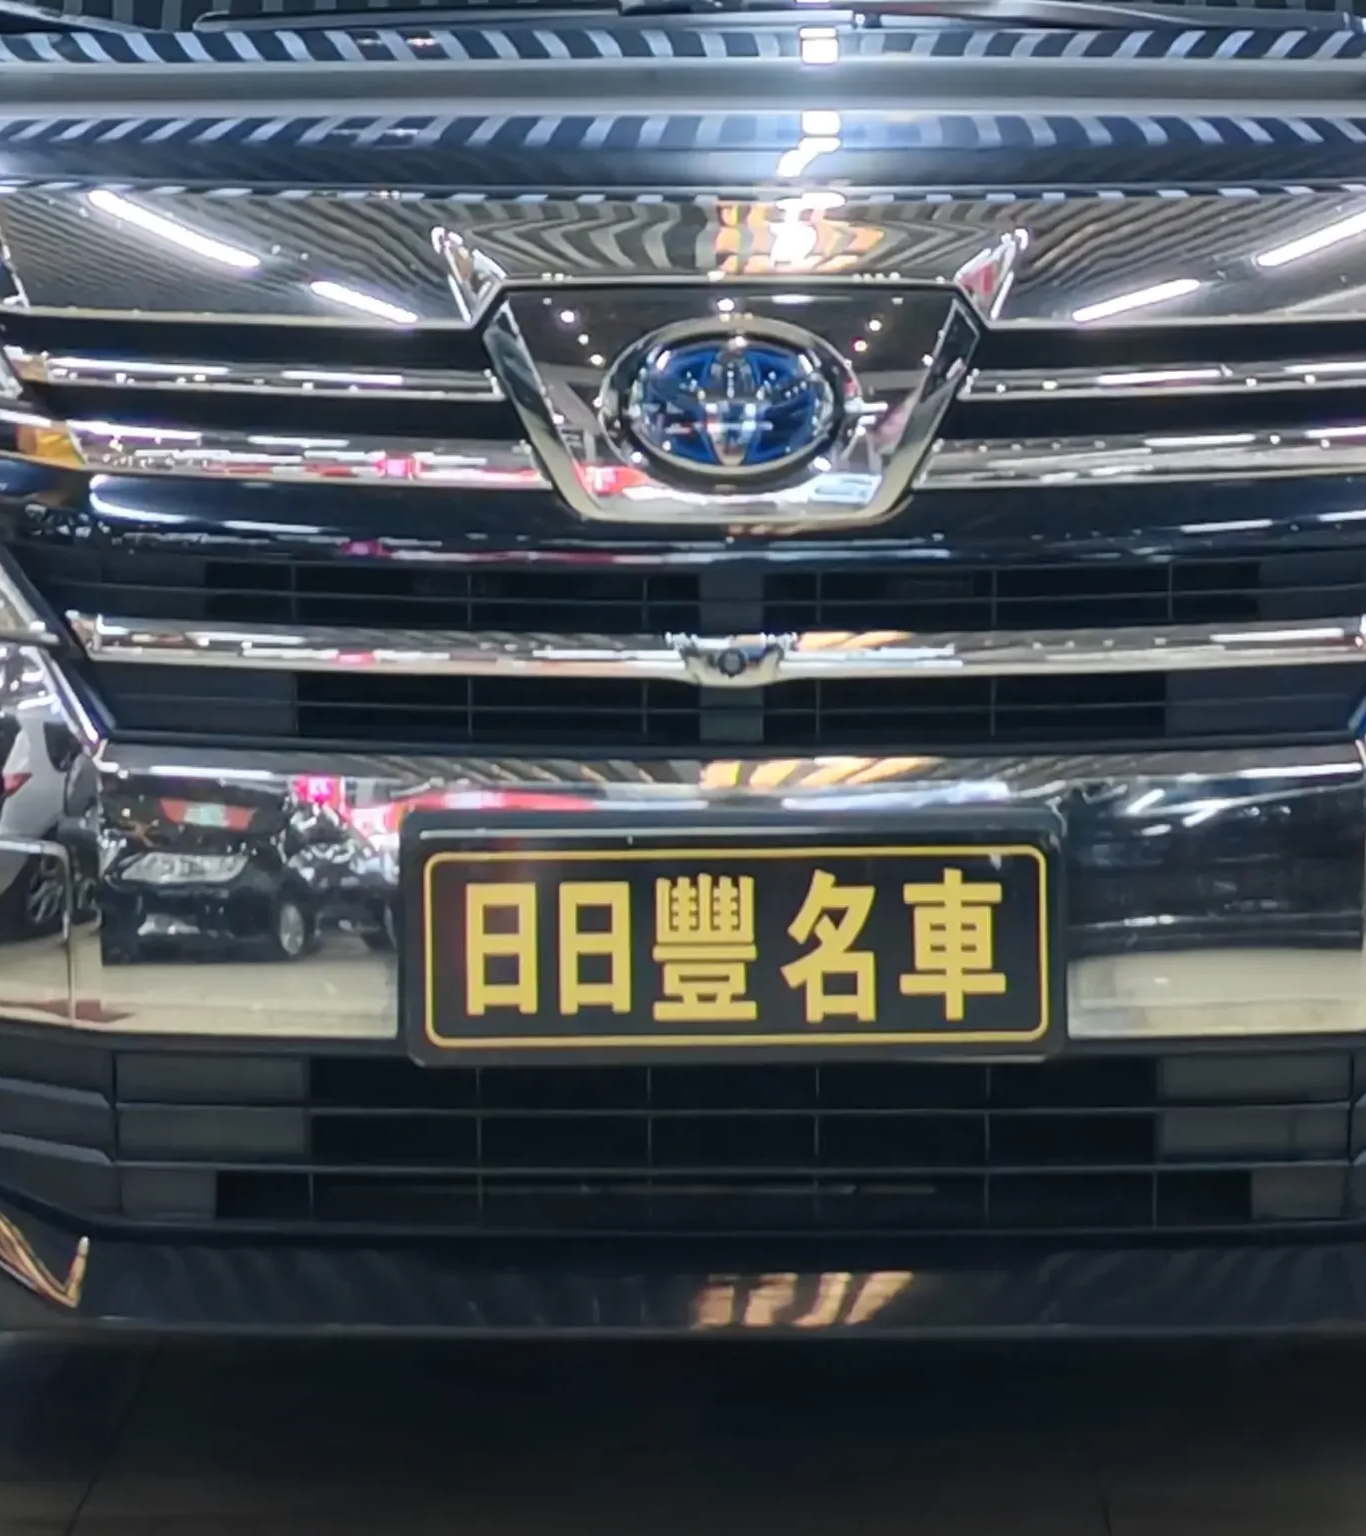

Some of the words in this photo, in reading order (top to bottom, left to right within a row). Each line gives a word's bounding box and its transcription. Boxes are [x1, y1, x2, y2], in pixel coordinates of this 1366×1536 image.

[464, 868, 1007, 1022] 日日豐名車
